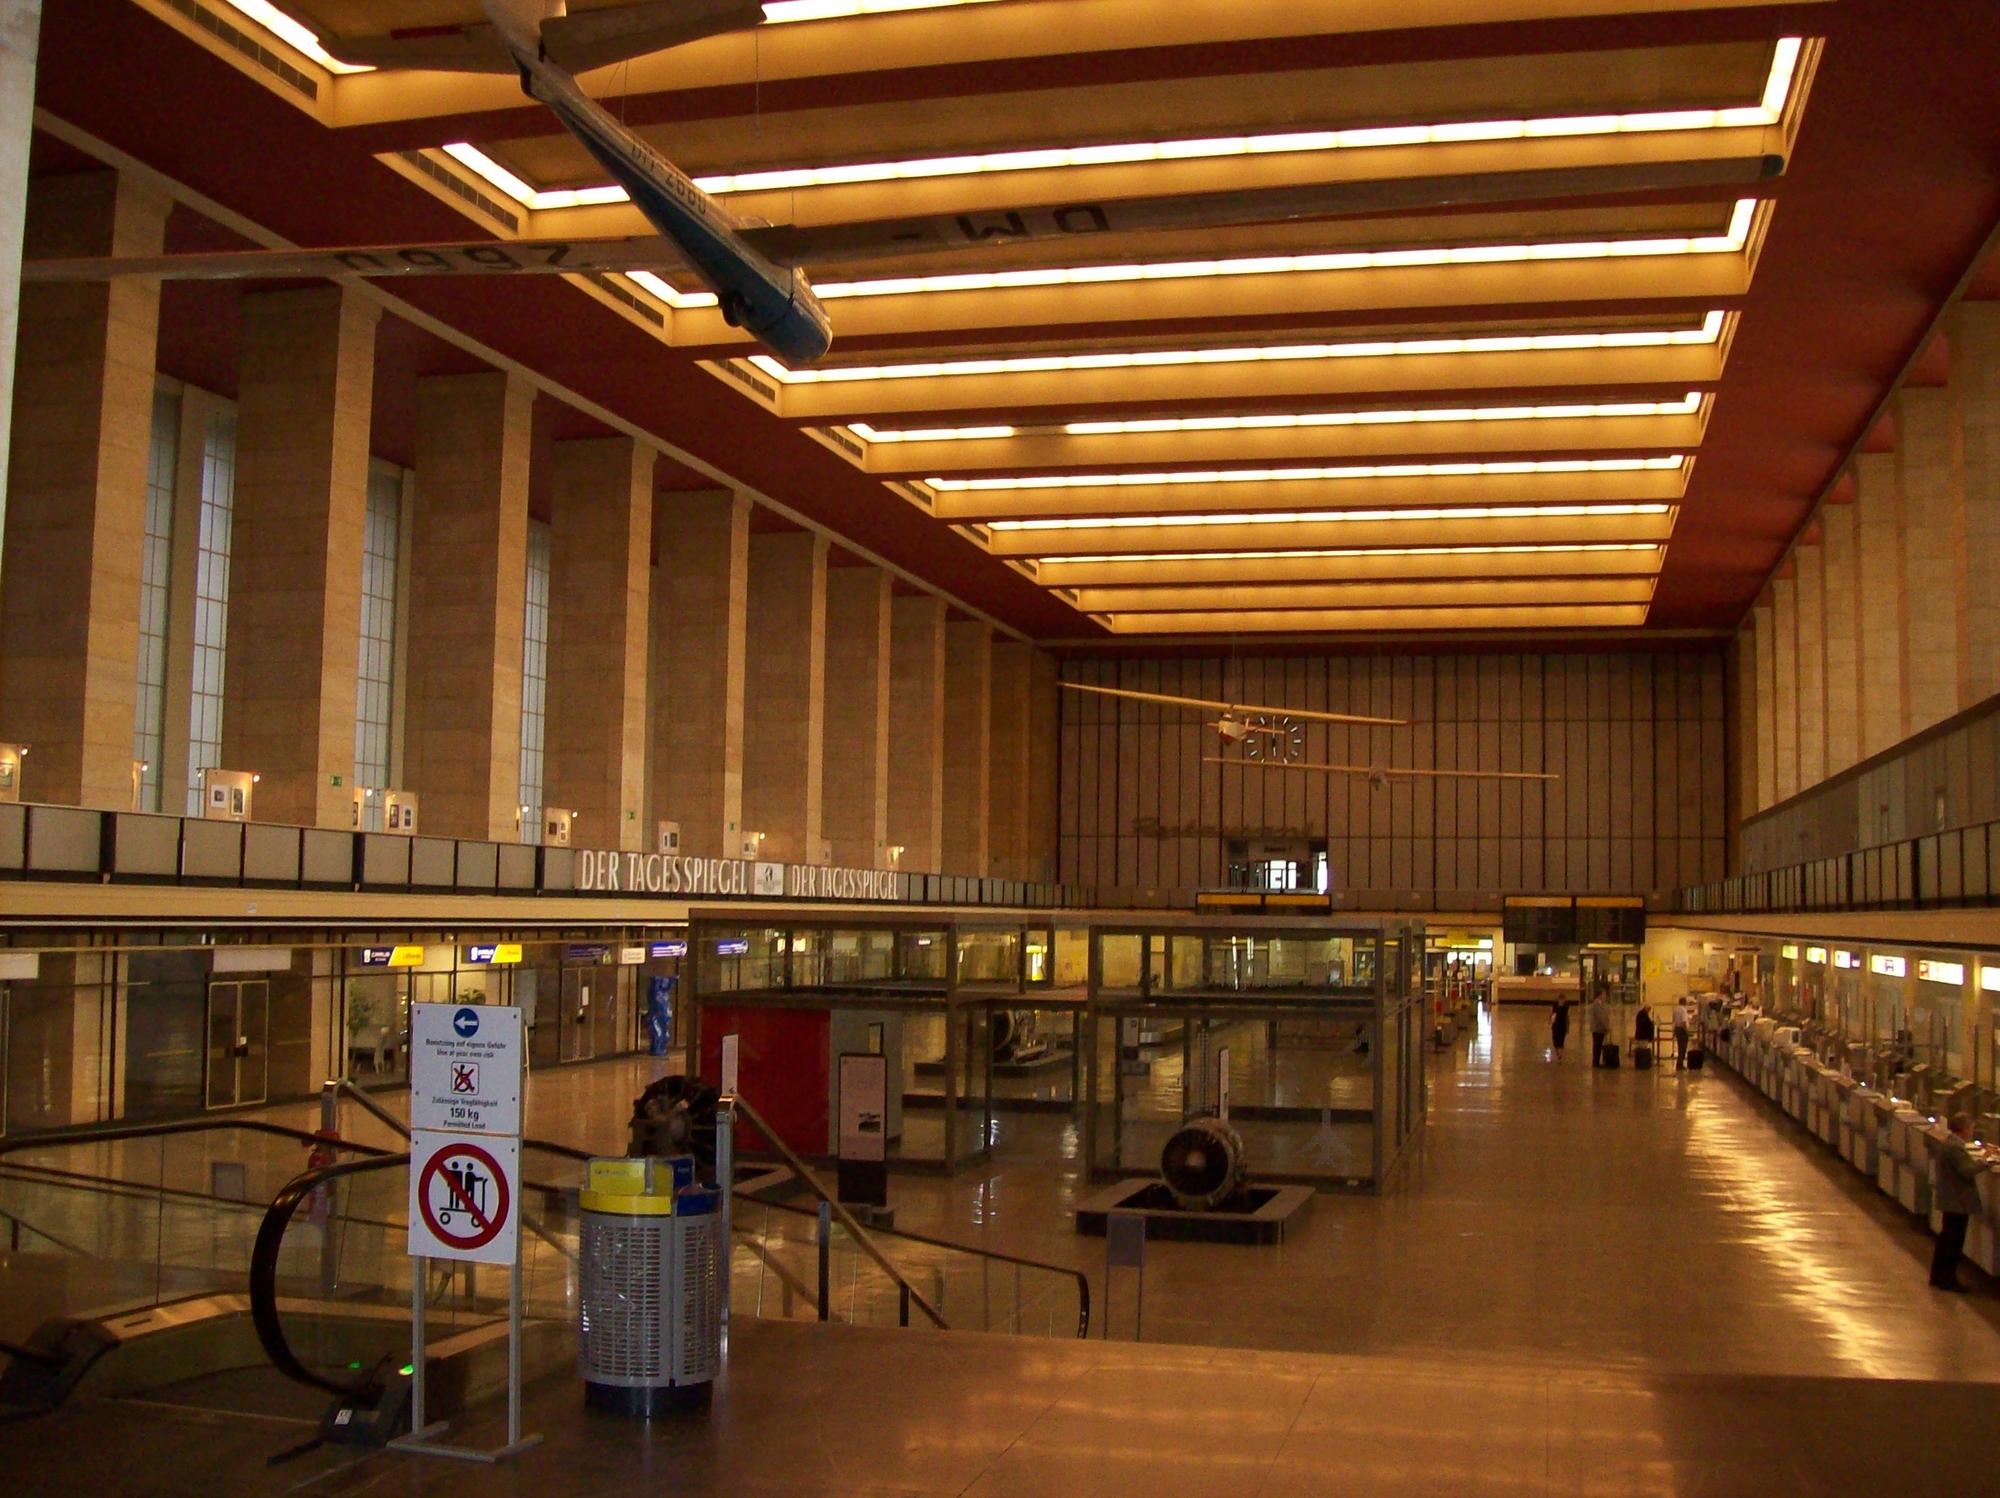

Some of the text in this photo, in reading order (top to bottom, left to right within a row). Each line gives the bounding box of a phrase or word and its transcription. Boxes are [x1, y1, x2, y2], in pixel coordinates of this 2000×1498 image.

[582, 850, 748, 895] DER TAGESSPIEGEL
[791, 864, 899, 900] DER TAGESSPIEGEL
[487, 1041, 506, 1049] Gefahr
[450, 1107, 479, 1122] 150 kg
[472, 1121, 486, 1129] Load
